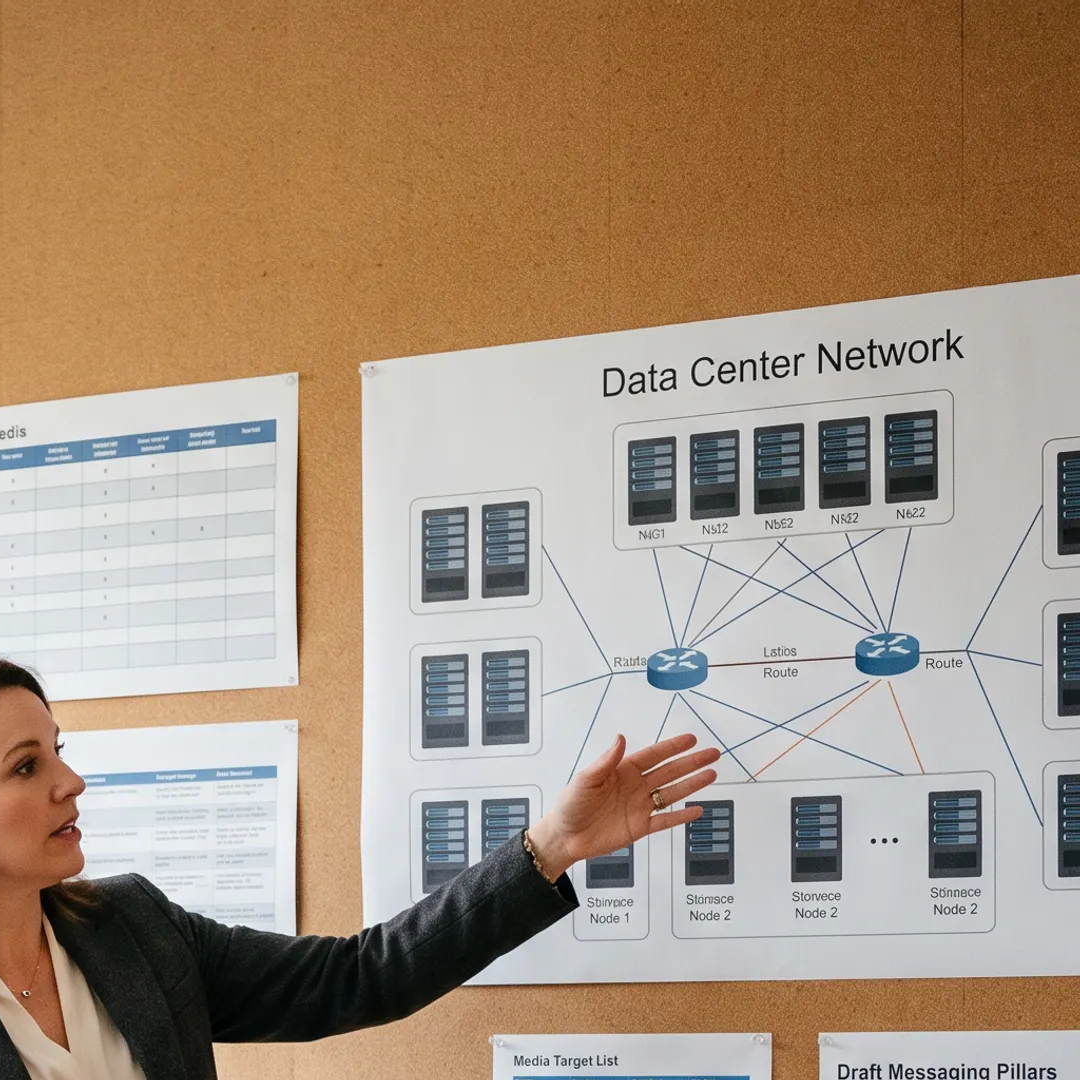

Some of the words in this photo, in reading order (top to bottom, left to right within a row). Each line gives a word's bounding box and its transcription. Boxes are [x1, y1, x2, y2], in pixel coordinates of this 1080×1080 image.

[603, 363, 678, 398] Data
[690, 350, 806, 388] Center
[818, 328, 965, 375] Network
[925, 657, 964, 670] Route
[763, 666, 799, 679] Route
[689, 910, 721, 922] Node
[723, 909, 731, 921] 2
[795, 907, 827, 919] Node
[830, 906, 838, 918] 2
[933, 903, 967, 916] Node
[970, 902, 978, 915] 2
[590, 913, 620, 924] Node
[624, 912, 629, 924] 1
[513, 1054, 550, 1067] Media
[553, 1054, 593, 1070] Target
[596, 1054, 619, 1067] List
[837, 1063, 883, 1080] Draft
[997, 1062, 1058, 1080] Pillars
